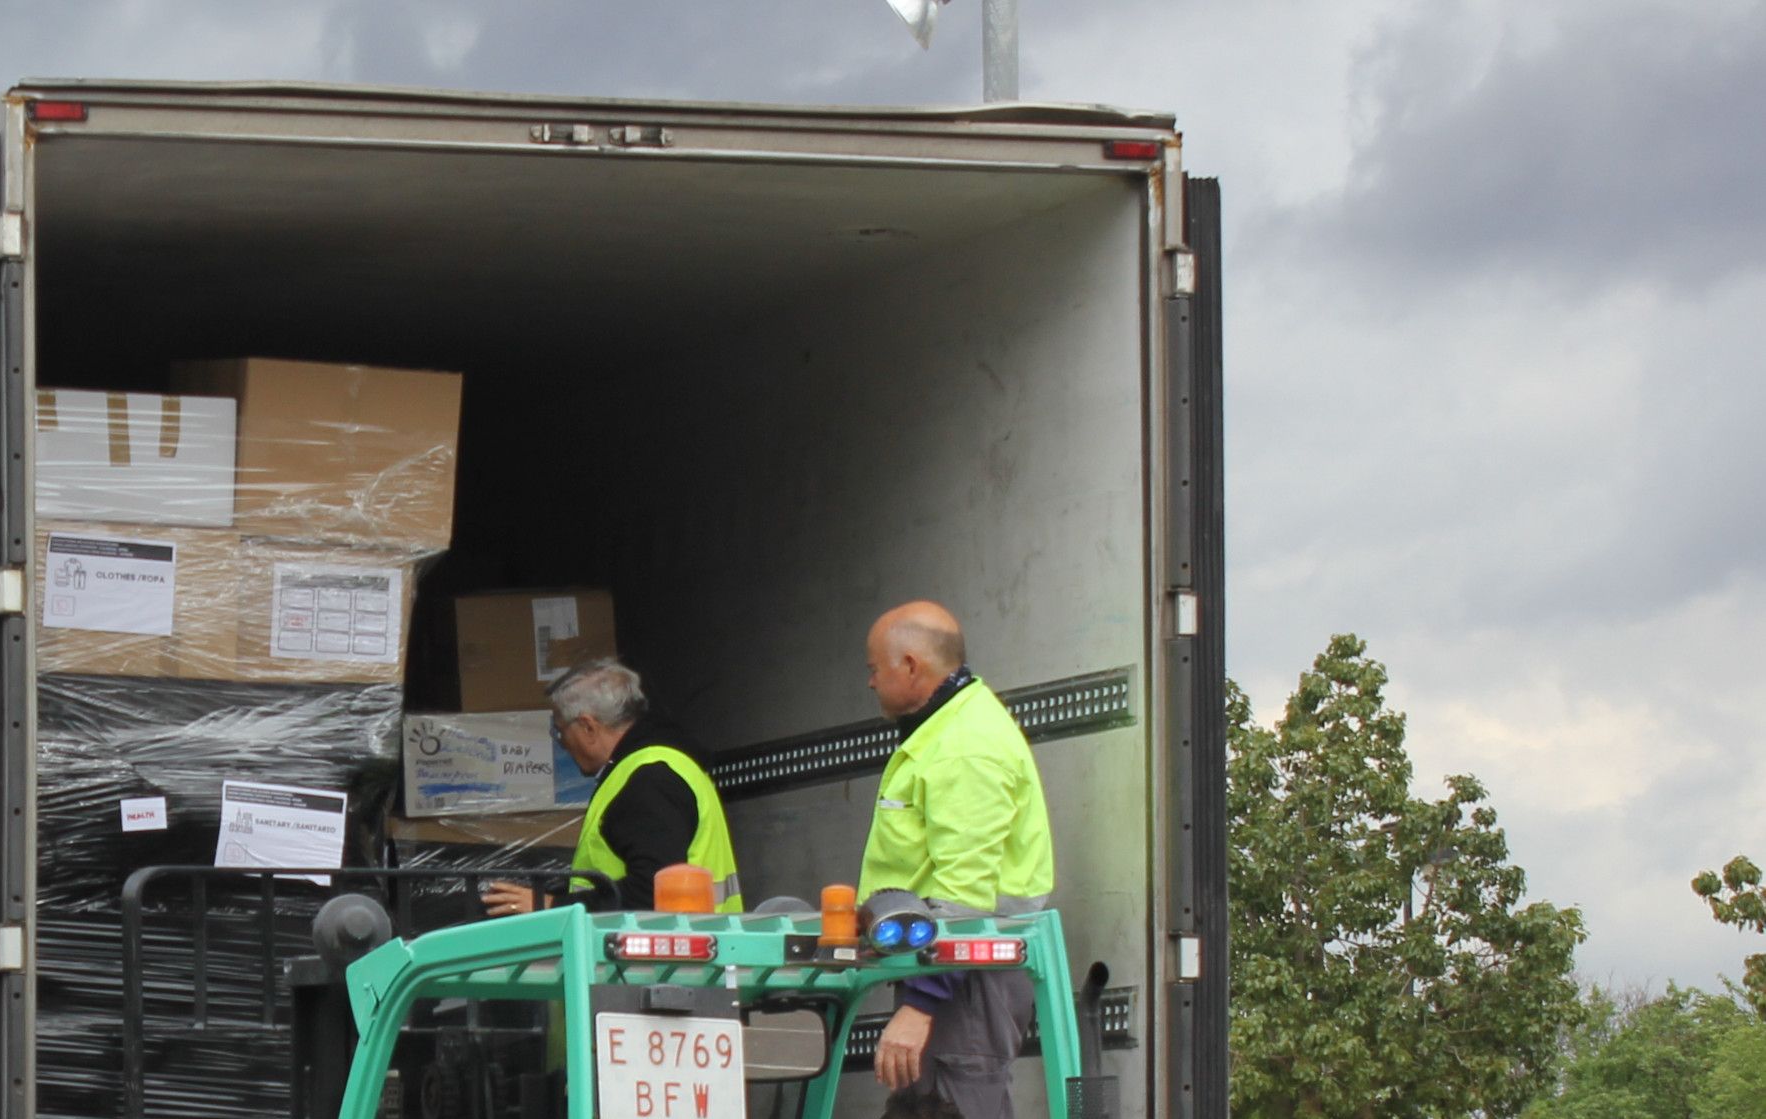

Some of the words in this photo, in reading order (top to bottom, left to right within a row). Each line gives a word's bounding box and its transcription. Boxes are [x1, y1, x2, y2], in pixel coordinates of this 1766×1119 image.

[96, 571, 135, 581] CLOTHES
[500, 744, 531, 758] BABY
[255, 818, 290, 830] SANITARY
[608, 1027, 627, 1065] E
[647, 1030, 733, 1068] 8769
